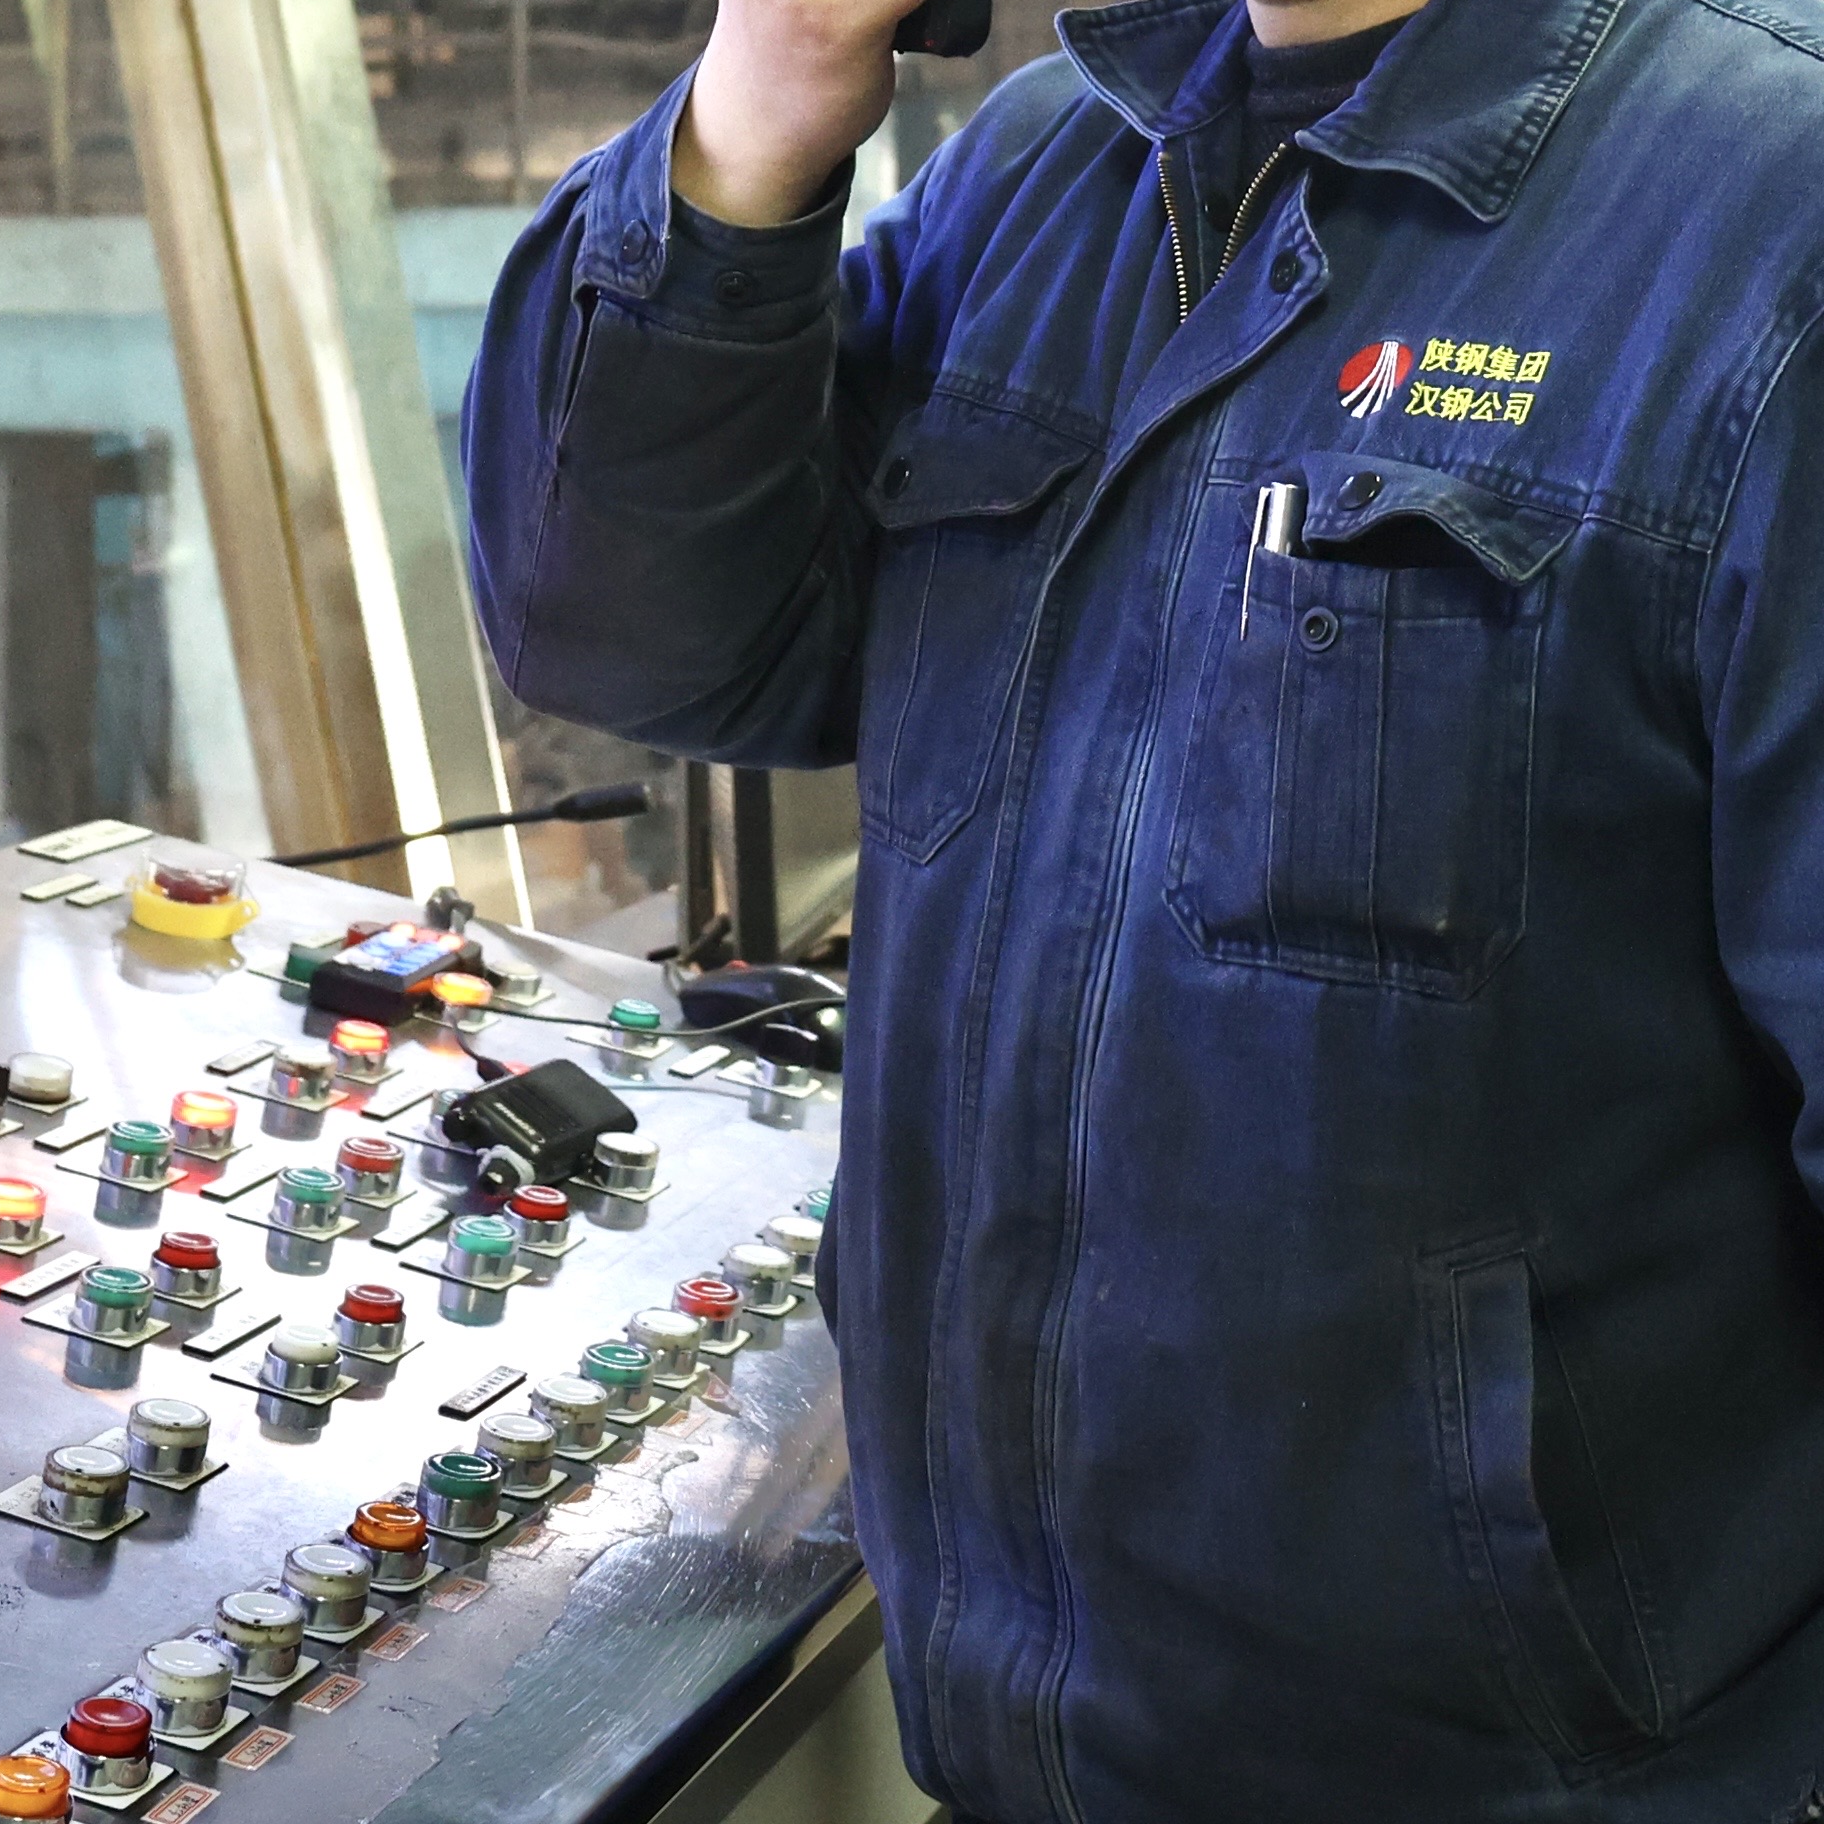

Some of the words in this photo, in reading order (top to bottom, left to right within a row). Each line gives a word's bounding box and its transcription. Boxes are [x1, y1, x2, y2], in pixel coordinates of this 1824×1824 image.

[1420, 338, 1550, 384] 陕钢集团
[1405, 381, 1535, 425] 汉钢公司
